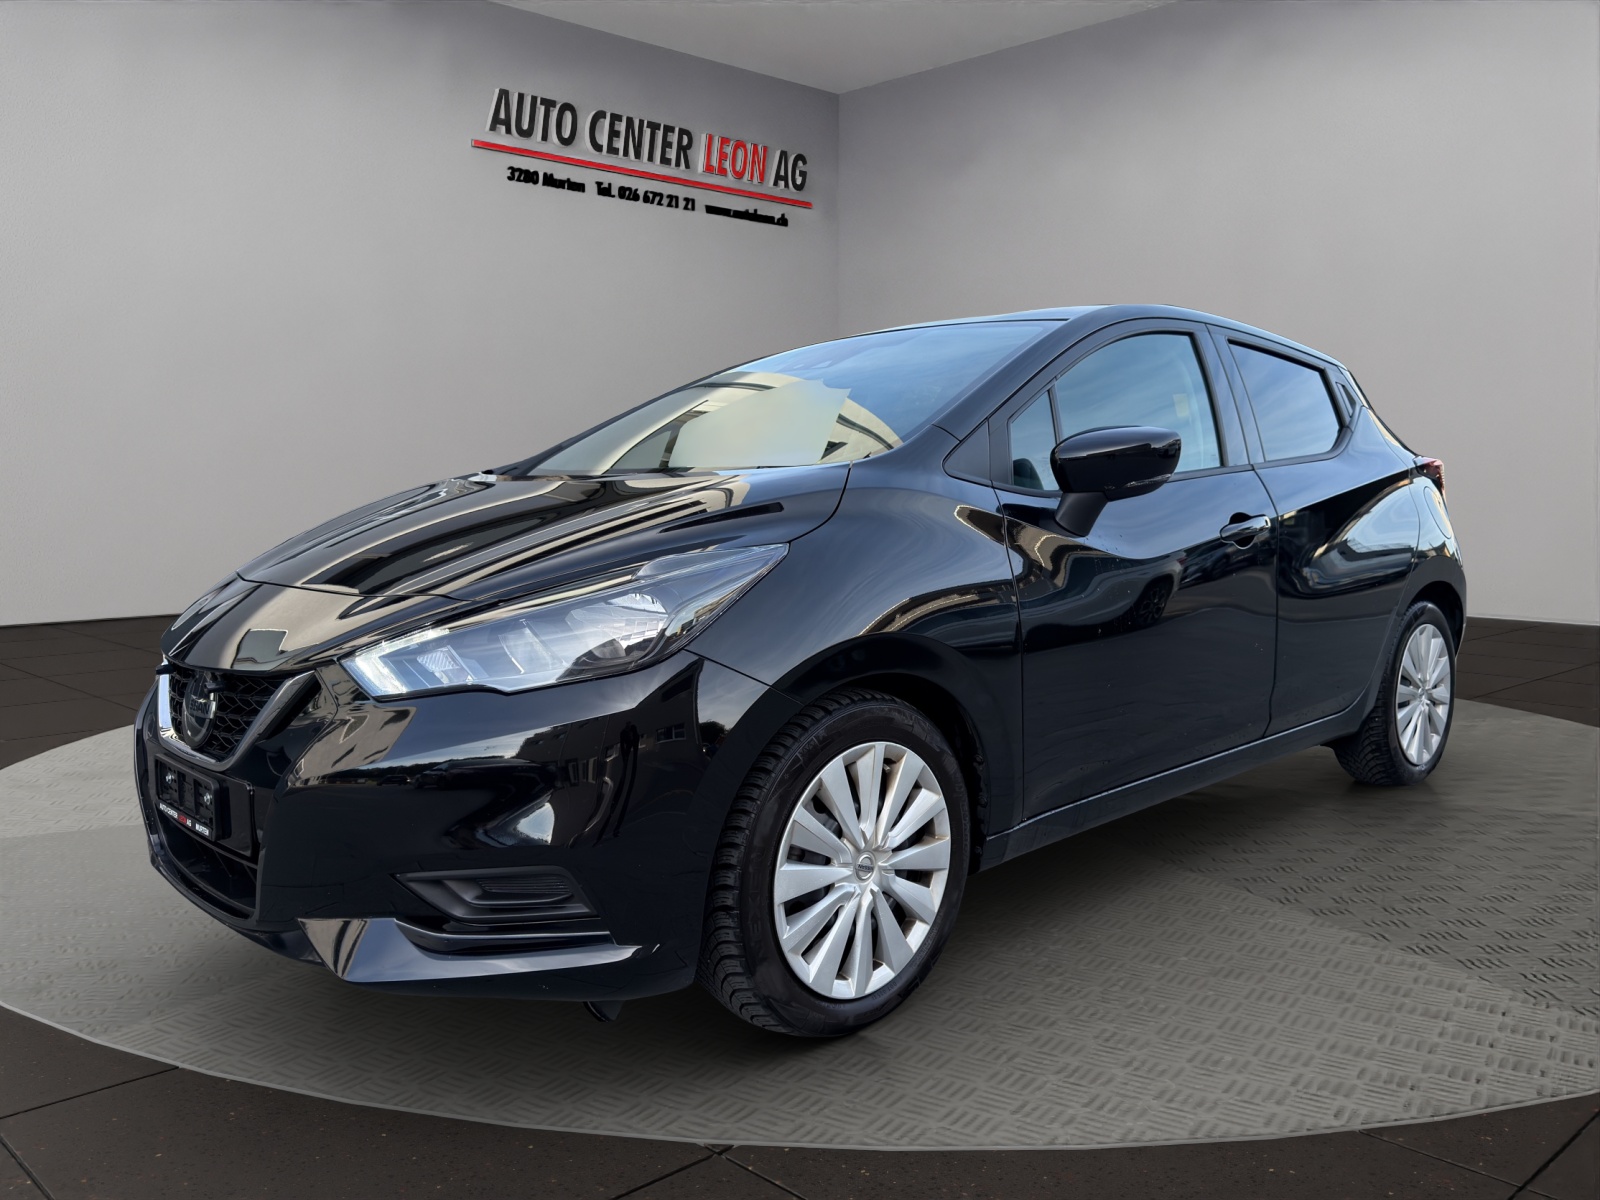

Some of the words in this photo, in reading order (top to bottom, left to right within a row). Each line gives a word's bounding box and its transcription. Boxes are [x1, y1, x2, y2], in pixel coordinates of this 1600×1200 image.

[487, 88, 578, 147] AUTO
[587, 109, 694, 170] CENTER
[701, 132, 768, 184] LEON
[772, 149, 808, 192] AG
[618, 186, 640, 202] 026
[643, 190, 664, 206] 672
[666, 194, 679, 209] 21
[683, 197, 696, 212] 21
